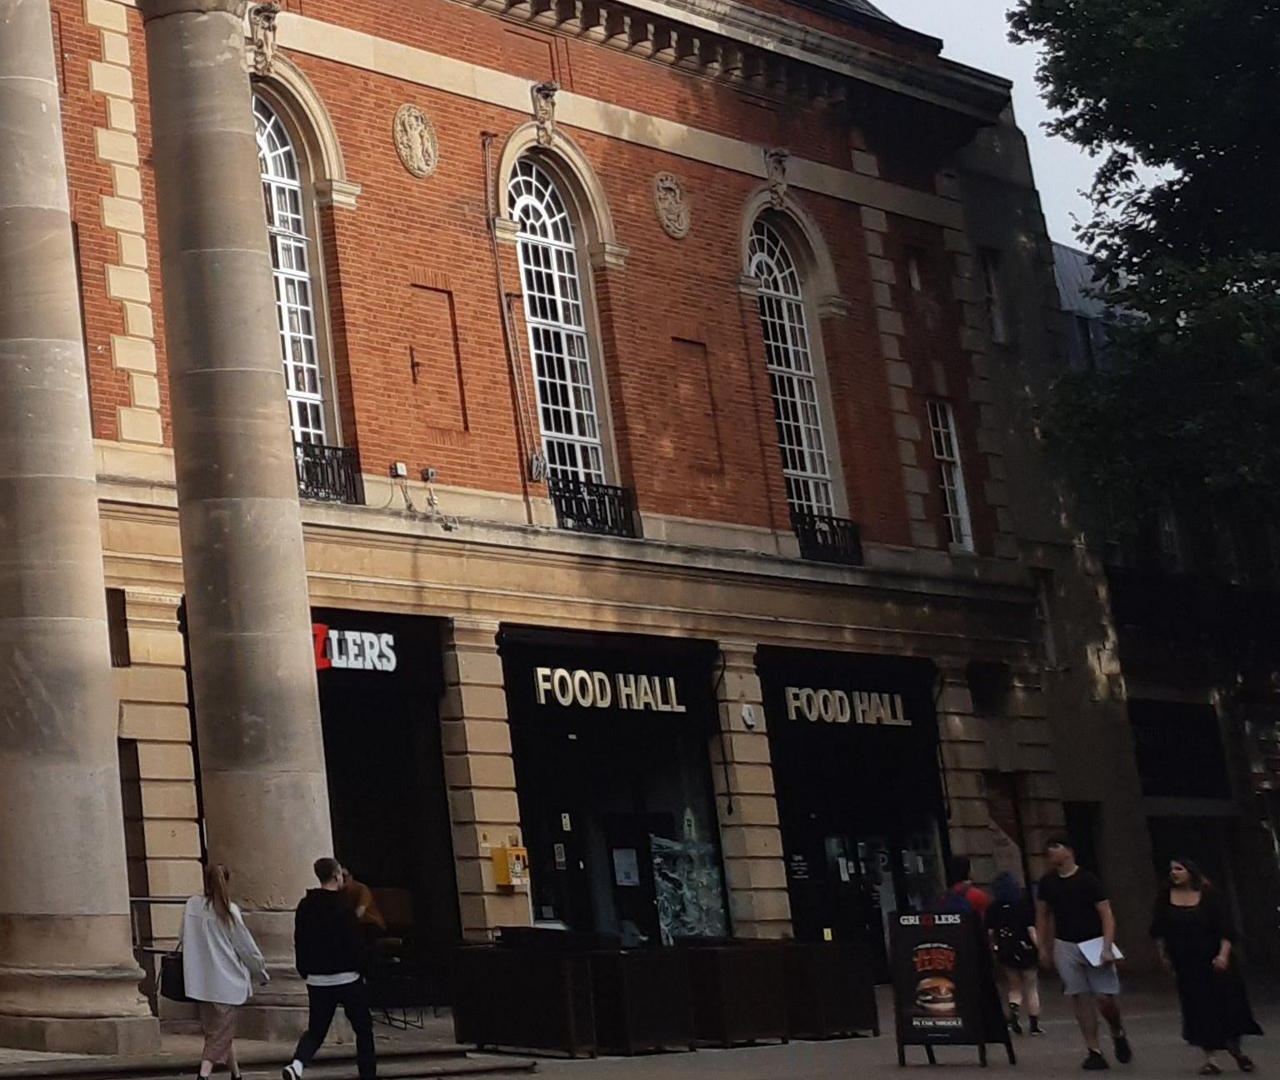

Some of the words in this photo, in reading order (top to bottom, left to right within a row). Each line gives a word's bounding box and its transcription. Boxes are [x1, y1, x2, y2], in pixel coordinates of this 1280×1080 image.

[533, 666, 612, 708] FOOD
[615, 672, 687, 712] HALL
[784, 686, 851, 723] FOOD
[852, 691, 912, 726] HALL
